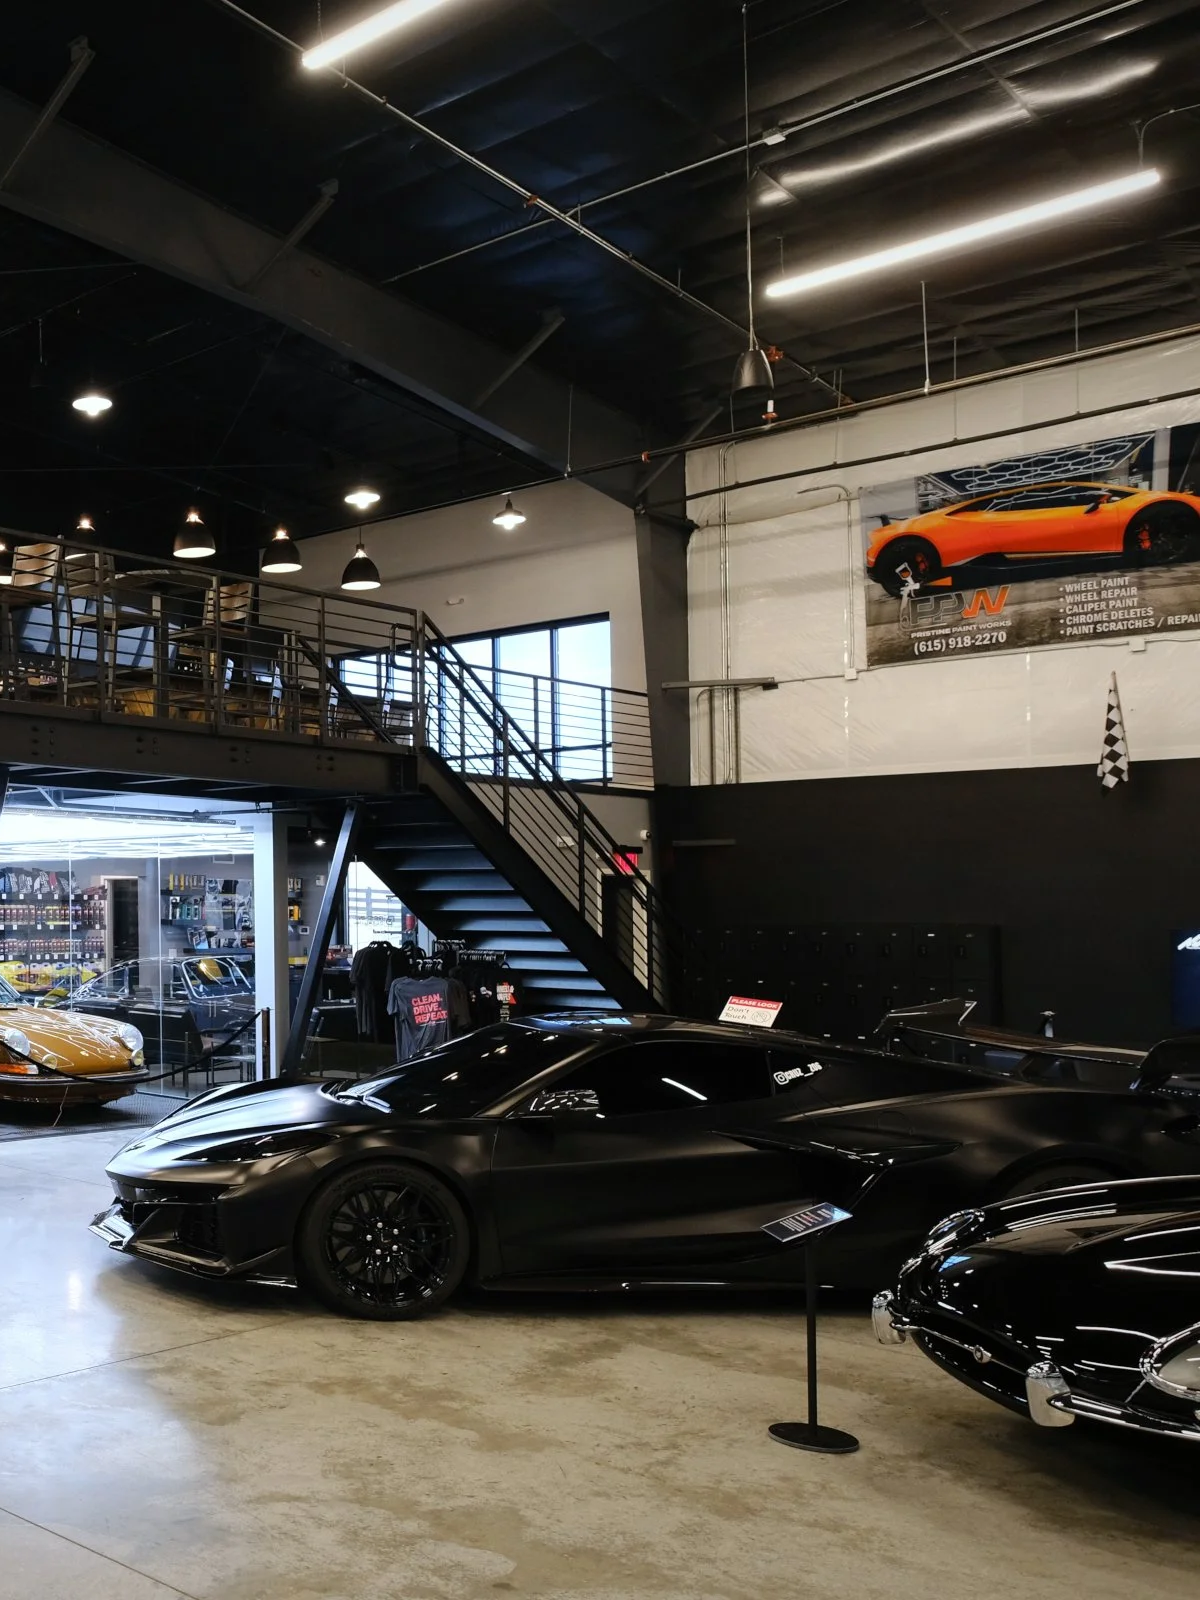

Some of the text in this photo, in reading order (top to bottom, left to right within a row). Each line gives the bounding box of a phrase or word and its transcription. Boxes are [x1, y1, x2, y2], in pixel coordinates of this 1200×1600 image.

[1065, 577, 1130, 593] WHEEL PAINT
[1065, 587, 1138, 604] WHEEL REPAIR
[1066, 598, 1139, 614] CALIPER PAINT
[1066, 607, 1154, 625] CHROME DELETES
[911, 620, 1012, 638] PRISTINE PAINT WORKS
[1066, 624, 1095, 636] PAINT
[1096, 618, 1155, 632] SCRATCHES
[914, 631, 1007, 655] (615) 918-2270
[727, 1006, 750, 1014] Don't
[731, 998, 778, 1009] PLEASE LOOK
[725, 1012, 747, 1020] Touch
